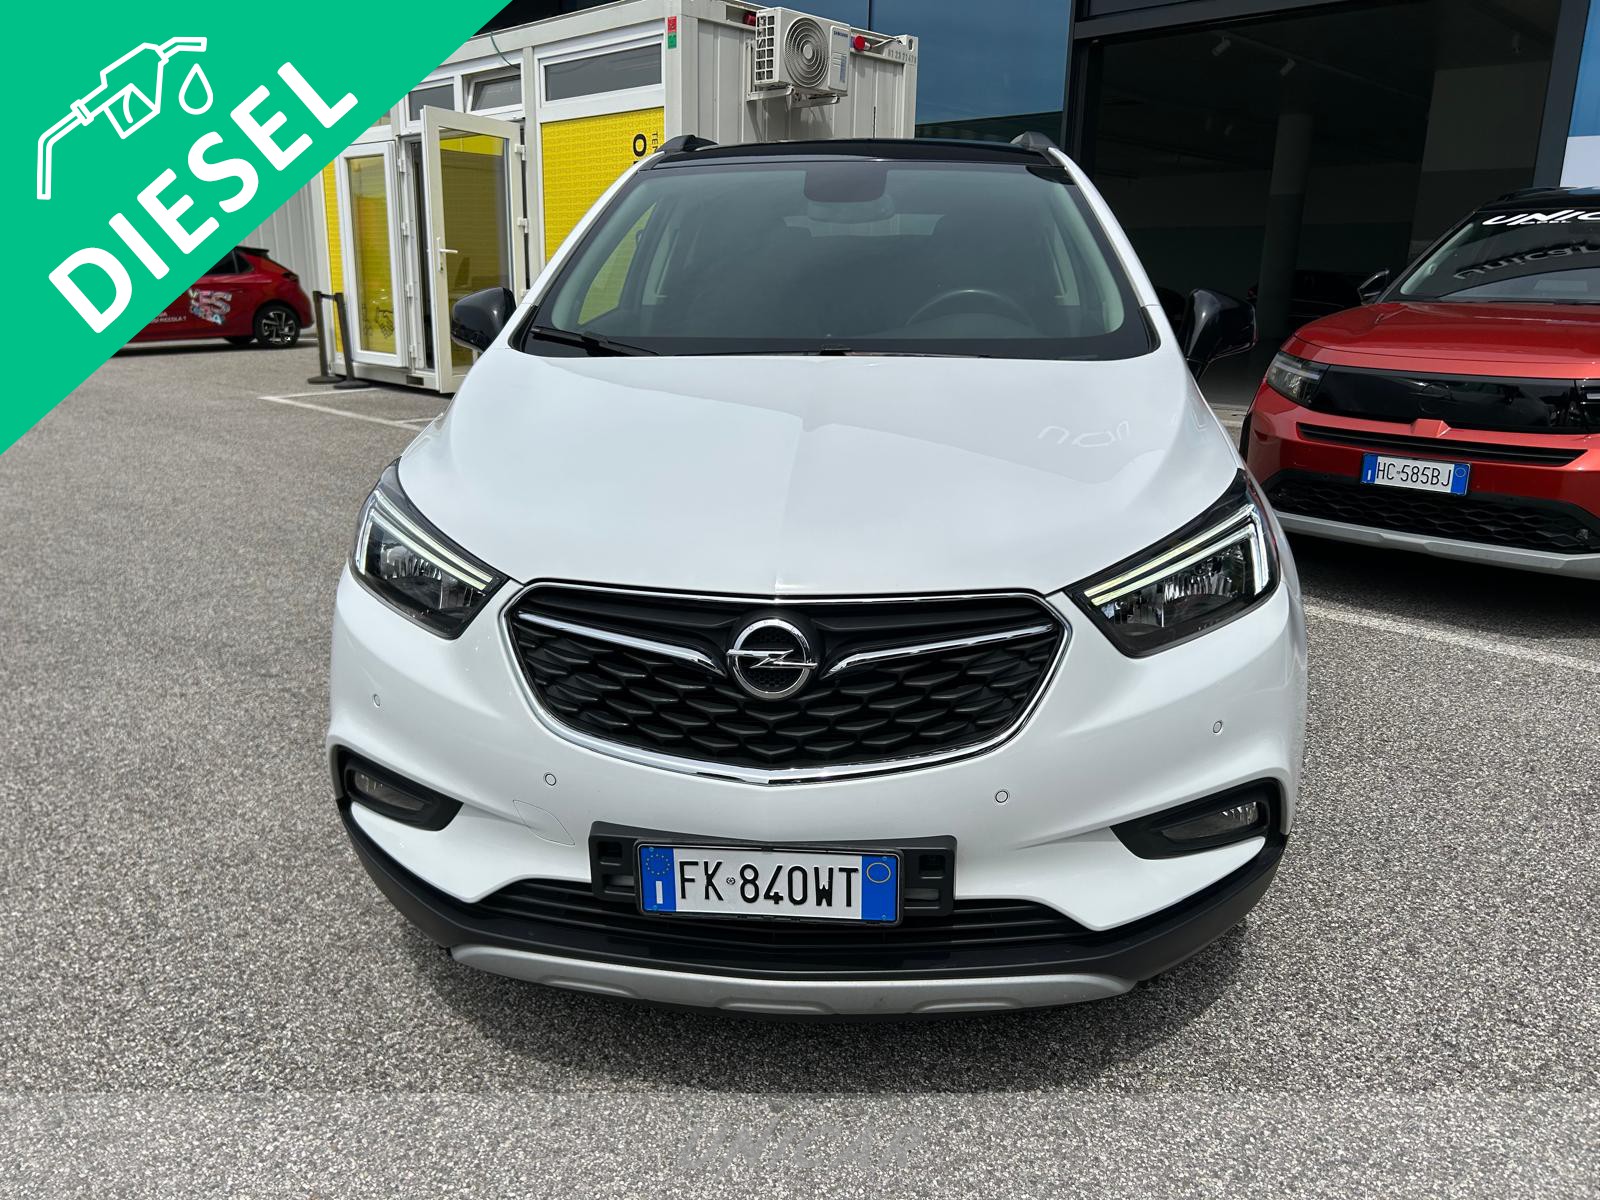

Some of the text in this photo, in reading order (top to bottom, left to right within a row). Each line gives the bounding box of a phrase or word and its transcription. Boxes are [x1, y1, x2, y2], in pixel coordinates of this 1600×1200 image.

[1376, 462, 1452, 486] HC 585BJ
[678, 860, 859, 908] FK 840WT
